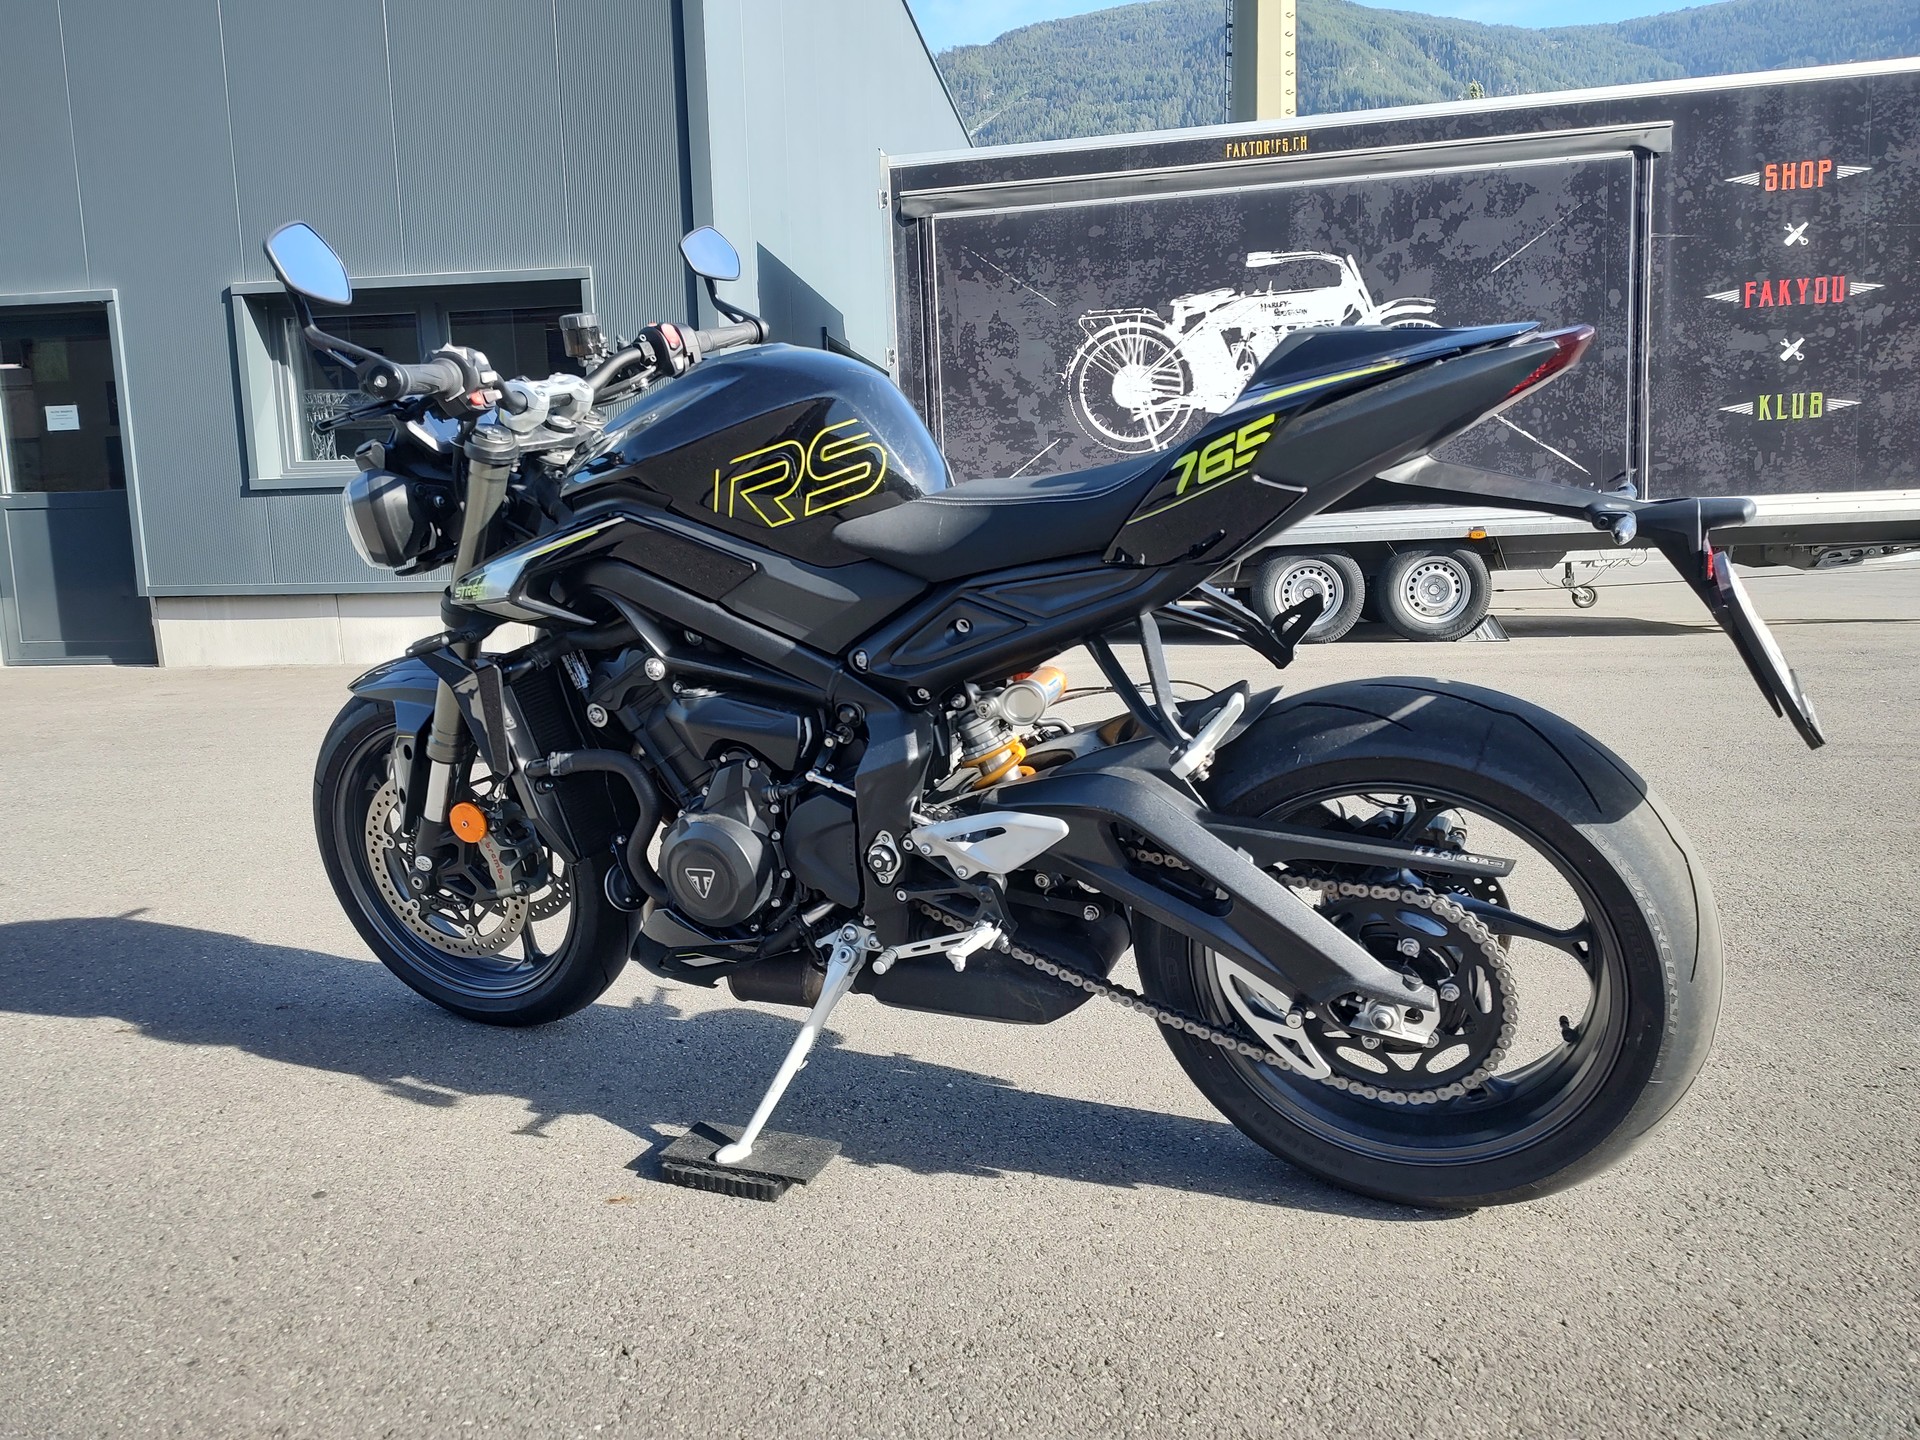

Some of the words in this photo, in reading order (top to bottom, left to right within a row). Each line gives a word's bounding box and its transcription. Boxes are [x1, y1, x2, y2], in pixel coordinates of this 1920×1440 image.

[1764, 158, 1832, 191] SHOP
[1744, 276, 1845, 308] FAKYOU
[1758, 392, 1823, 420] KLUB
[1171, 413, 1275, 496] 765
[713, 418, 887, 528] RS
[485, 841, 504, 881] brembo
